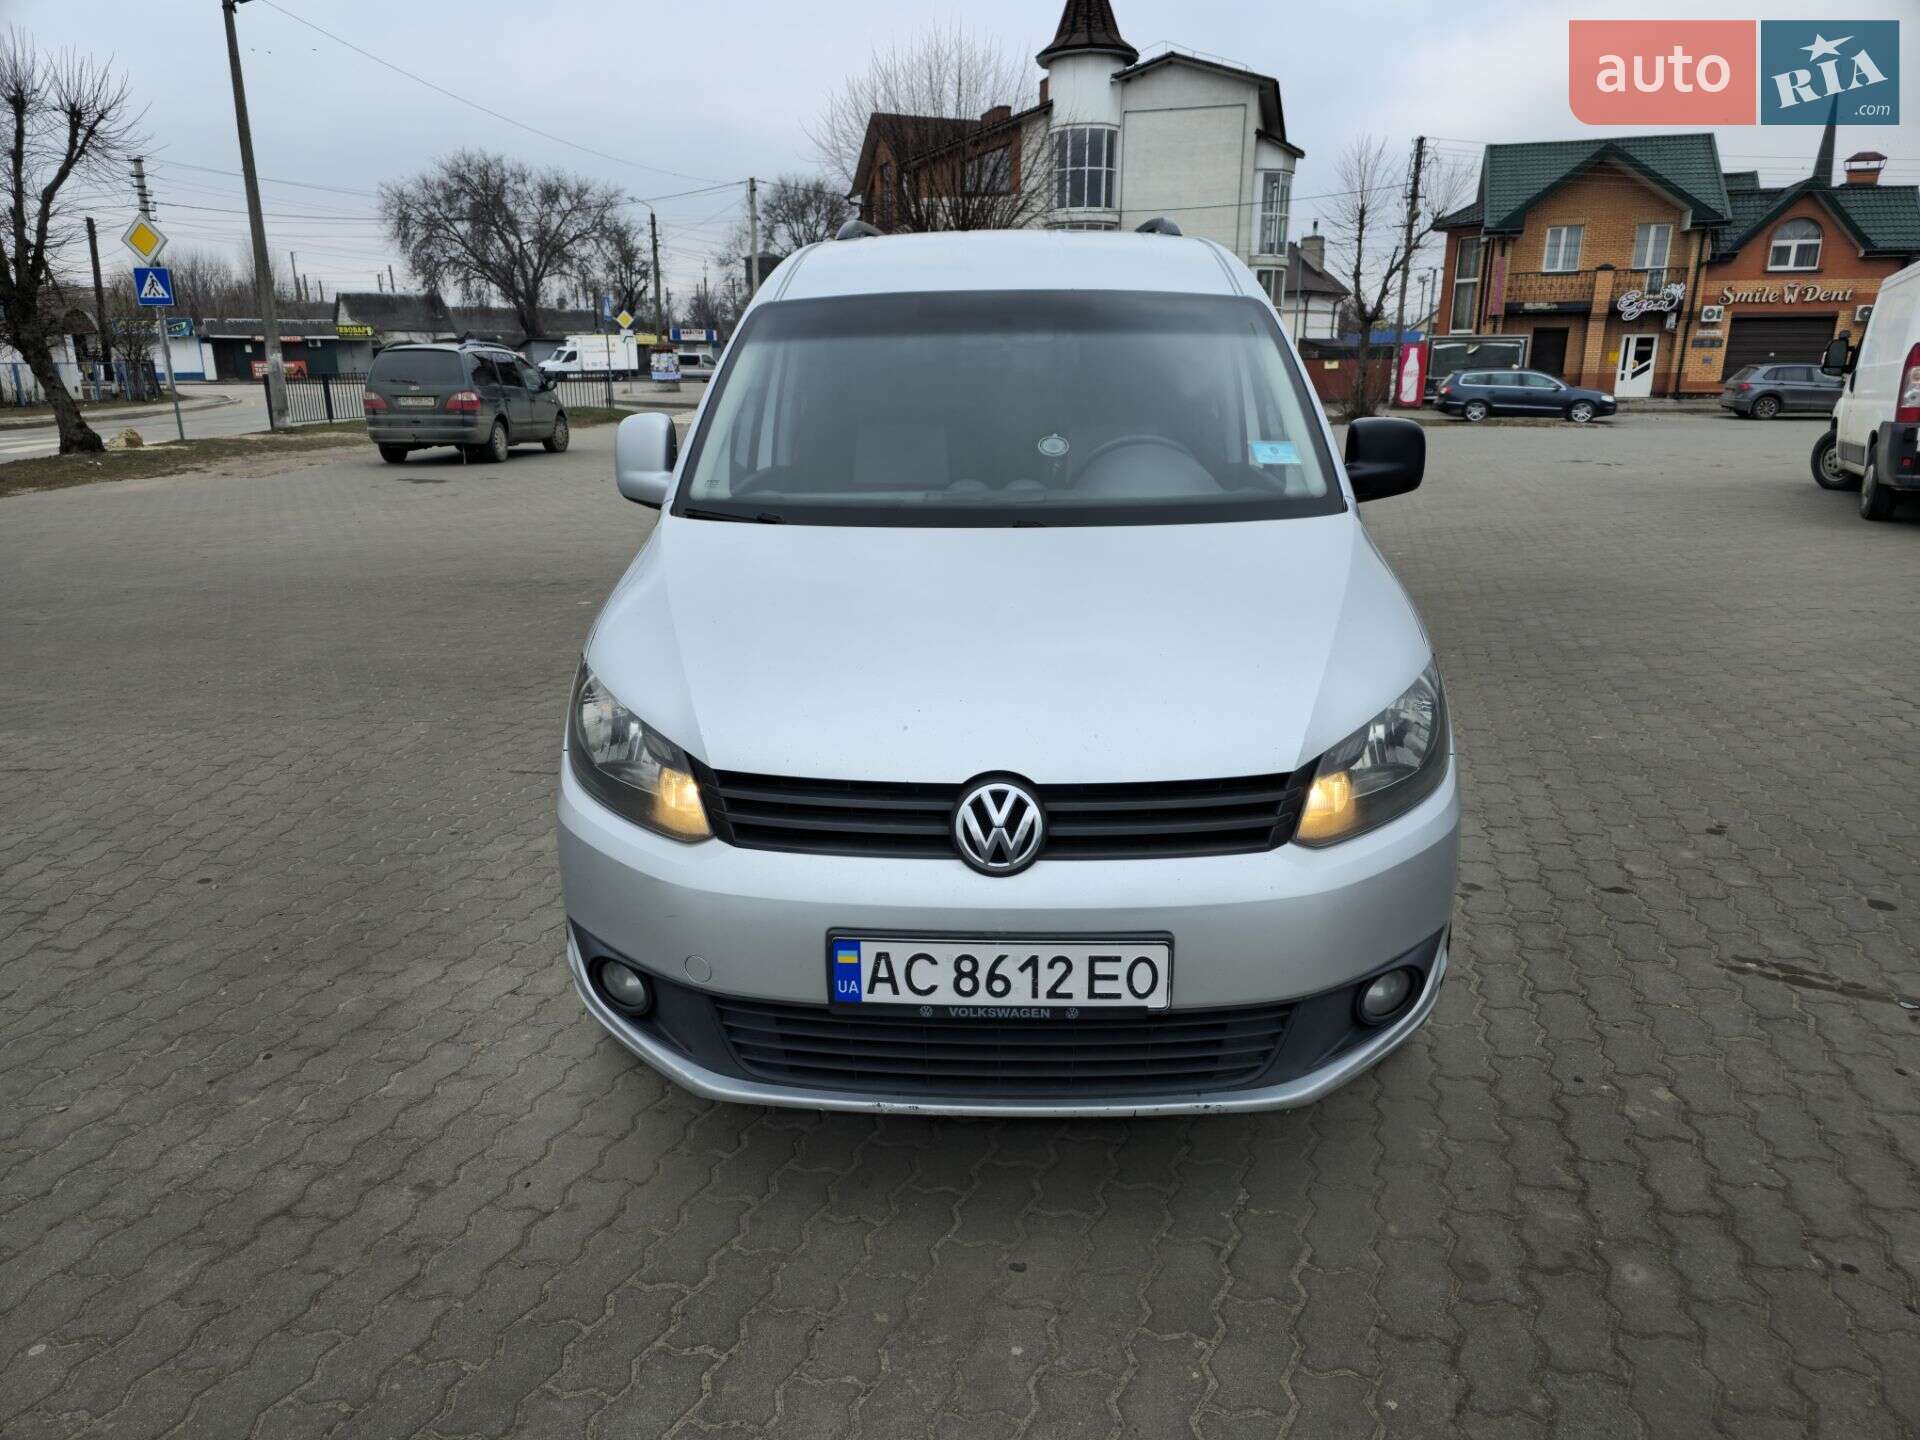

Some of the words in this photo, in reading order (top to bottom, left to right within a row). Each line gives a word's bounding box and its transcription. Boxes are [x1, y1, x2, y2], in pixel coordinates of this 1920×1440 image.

[1718, 286, 1780, 306] Smile
[1801, 284, 1856, 303] Dent
[866, 951, 939, 997] AC
[952, 953, 1074, 1000] 8612
[1087, 954, 1159, 1001] EO
[837, 979, 860, 994] UA
[948, 1006, 1051, 1019] VOLKSWAGEN
